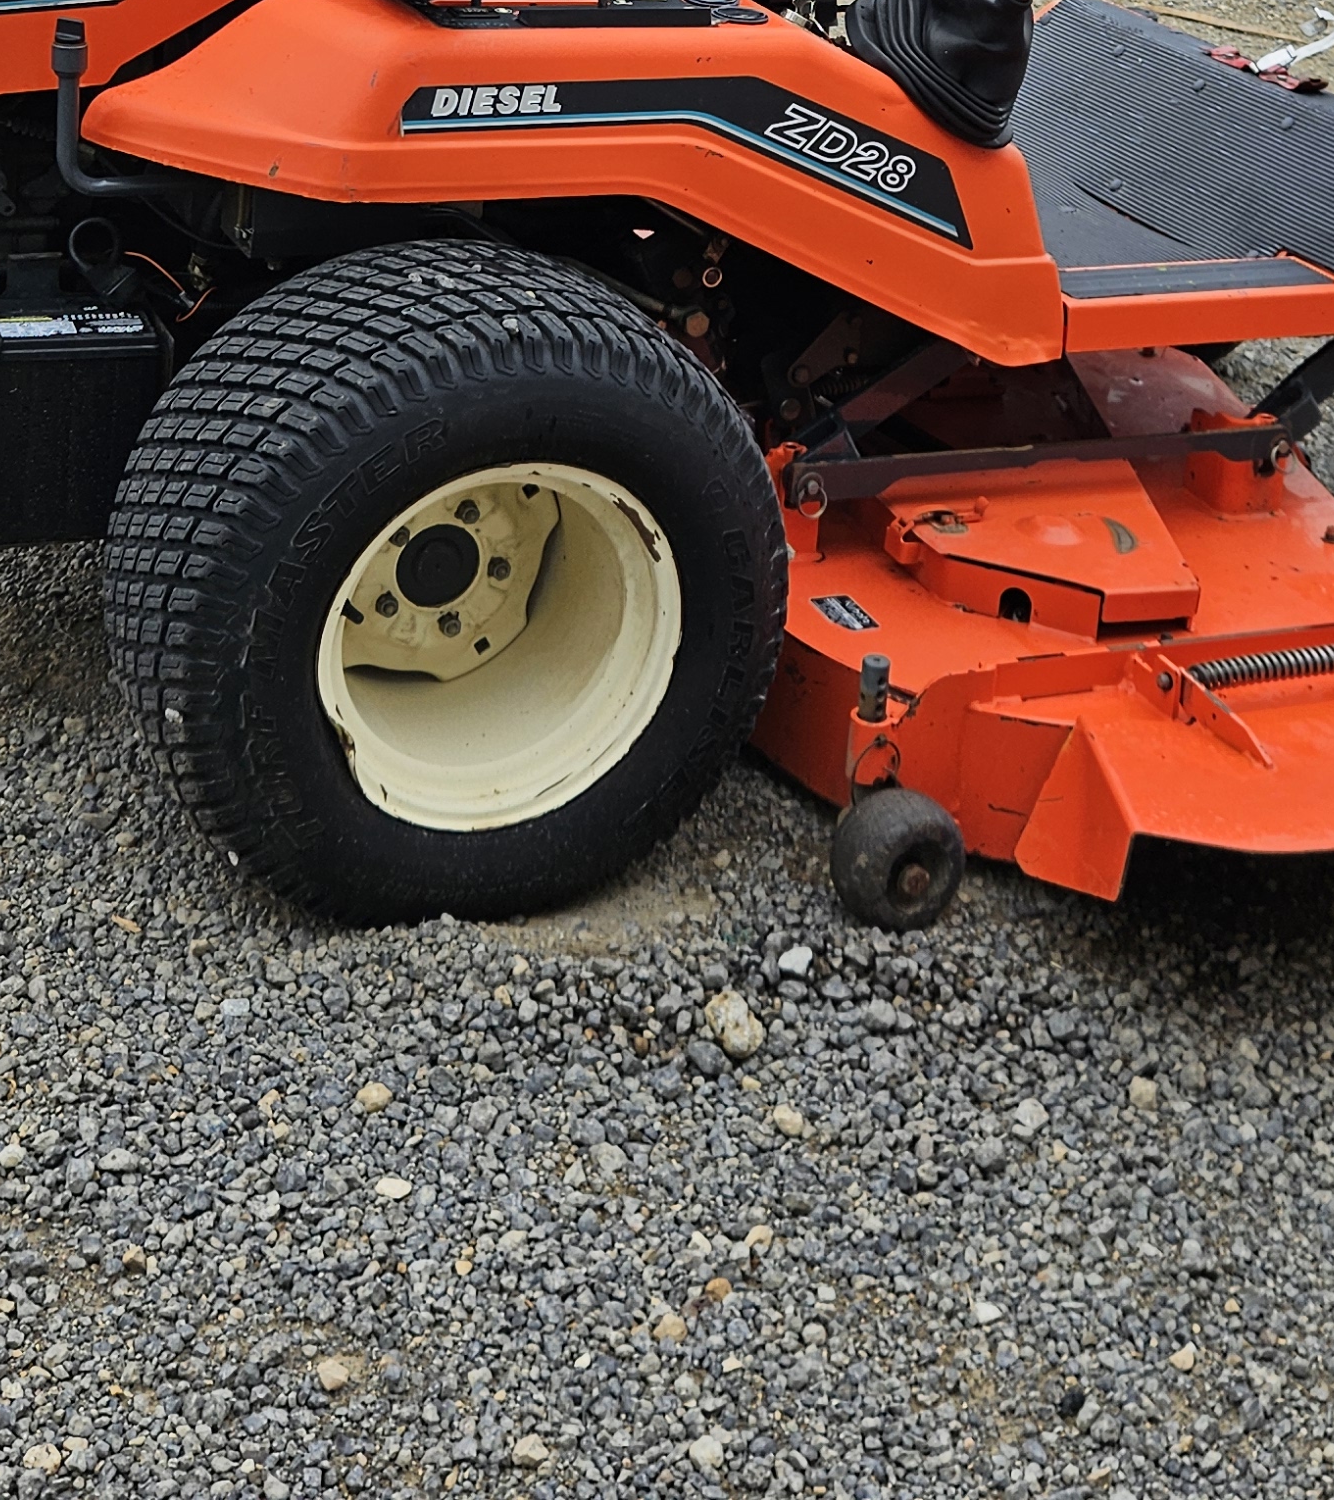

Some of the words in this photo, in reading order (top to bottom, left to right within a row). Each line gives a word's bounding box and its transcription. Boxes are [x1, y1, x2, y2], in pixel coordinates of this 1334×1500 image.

[431, 84, 562, 117] DIESEL
[764, 102, 917, 193] ZD28
[239, 417, 449, 680] MASTER
